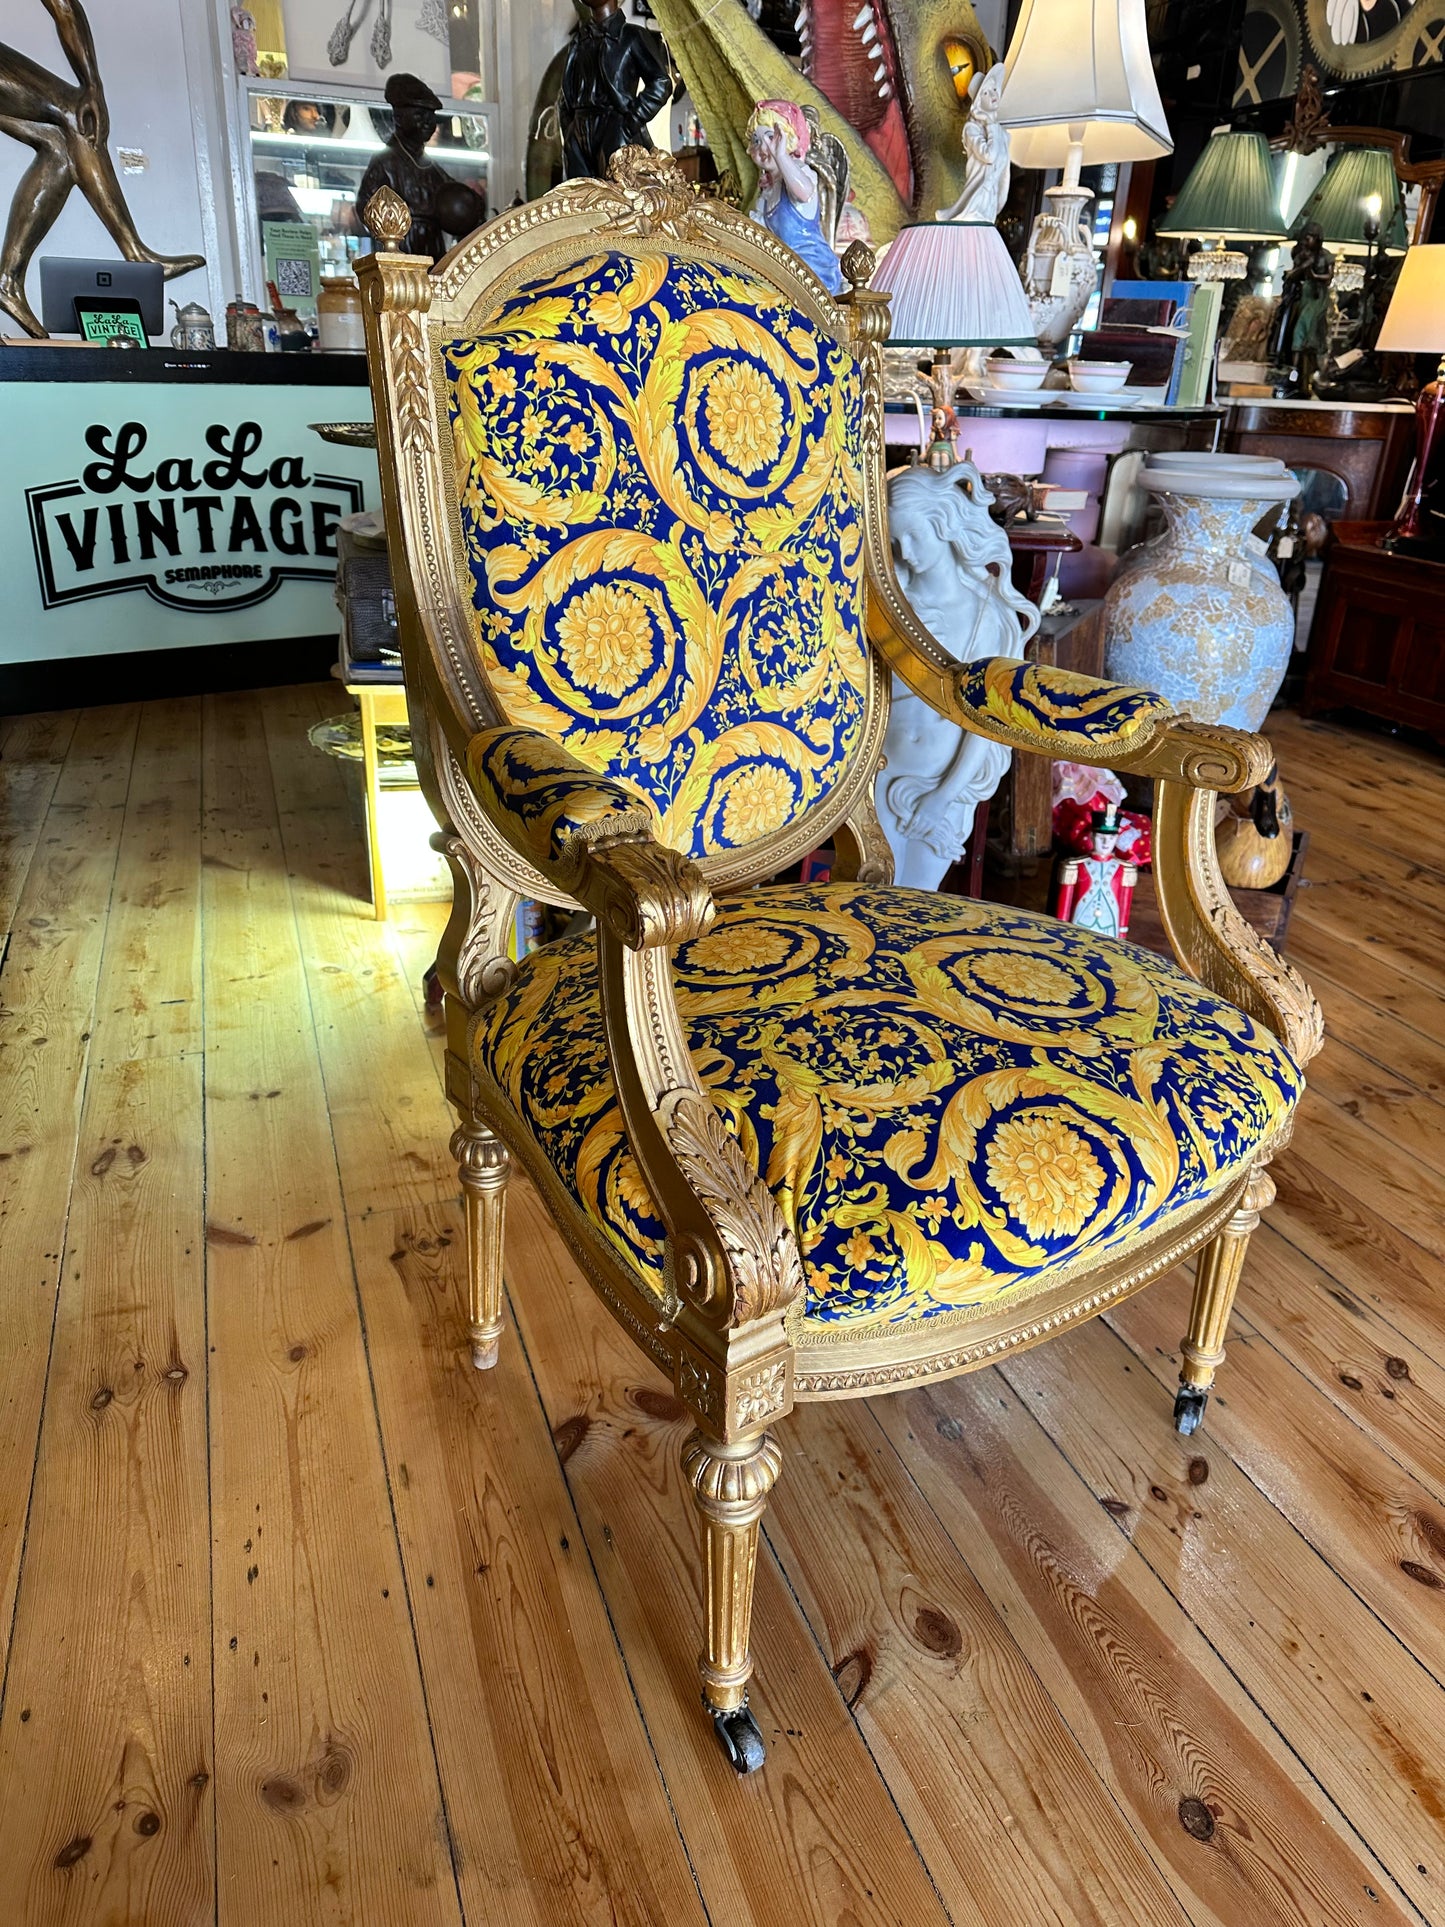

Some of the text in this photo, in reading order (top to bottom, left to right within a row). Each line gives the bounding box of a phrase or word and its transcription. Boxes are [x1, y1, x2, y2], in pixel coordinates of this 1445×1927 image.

[83, 421, 311, 493] LaLa
[55, 496, 342, 572] VINTAGE
[164, 564, 263, 585] SEMAPHORE
